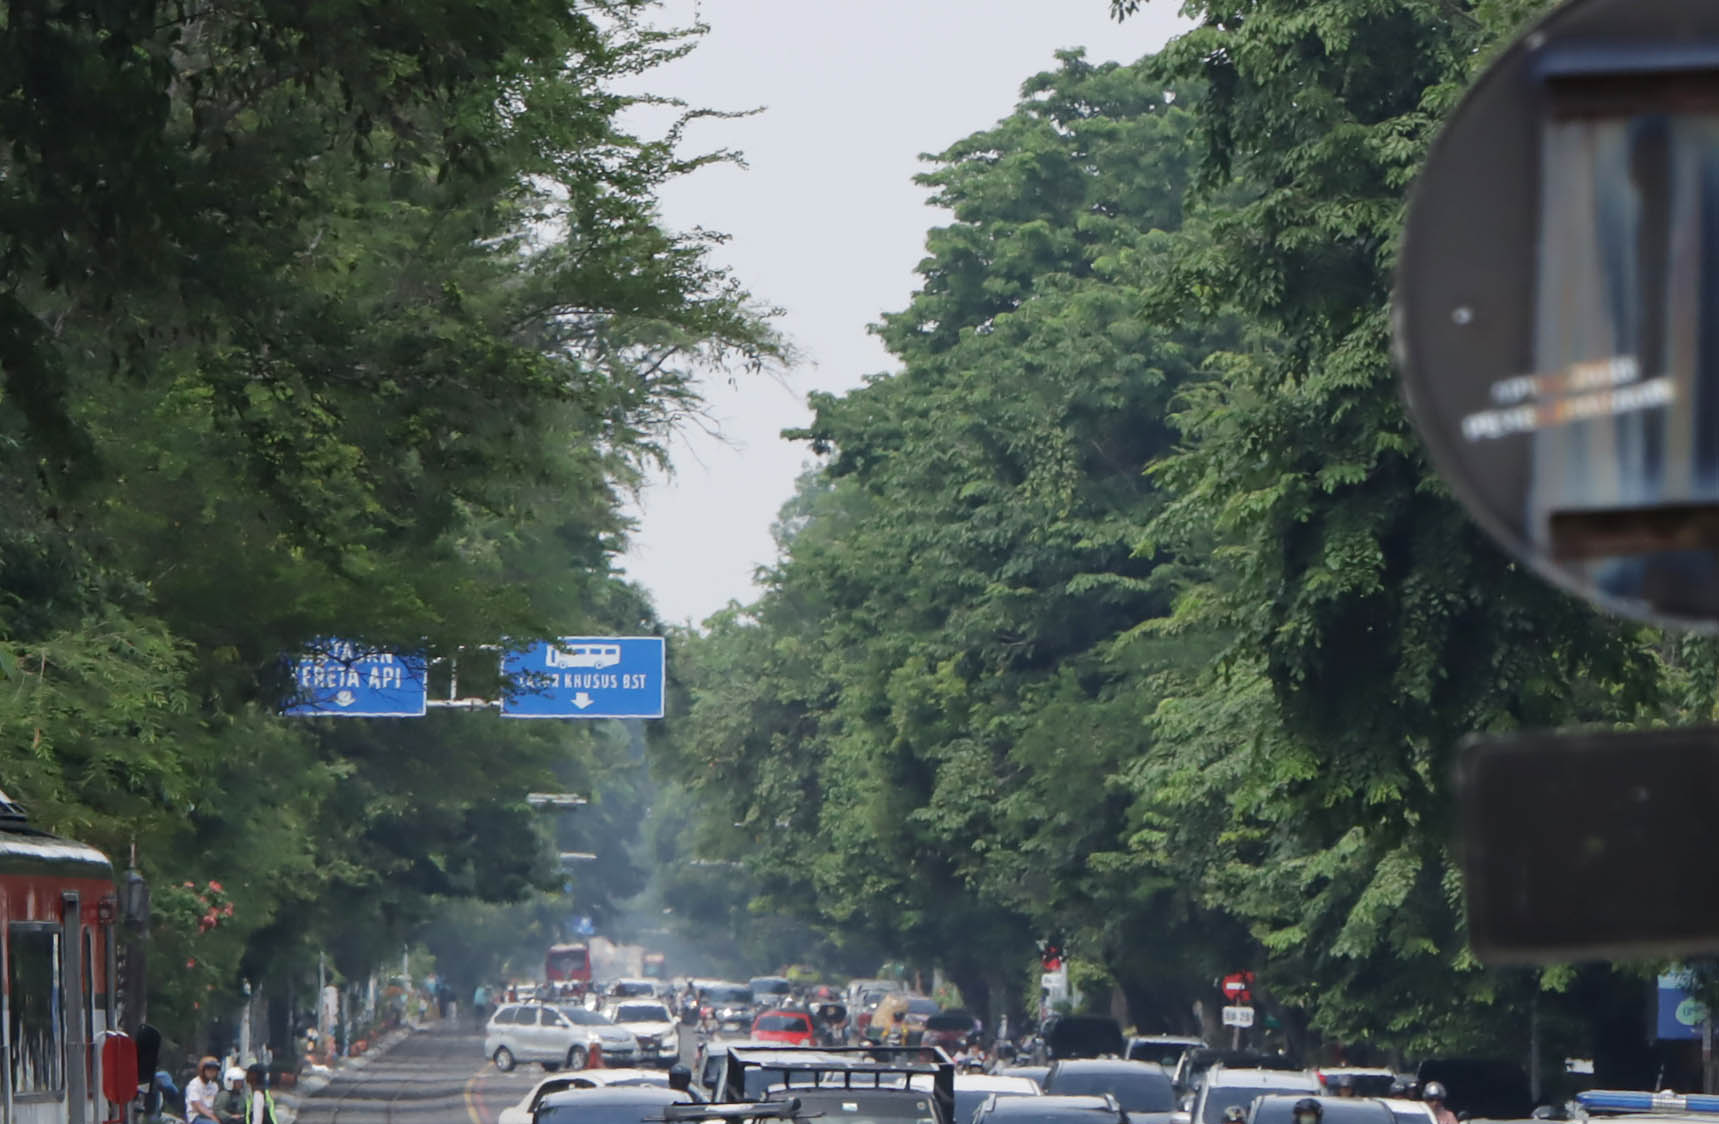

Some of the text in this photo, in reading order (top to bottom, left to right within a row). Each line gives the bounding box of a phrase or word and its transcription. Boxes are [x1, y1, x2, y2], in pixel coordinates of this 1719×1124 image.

[368, 667, 401, 689] API
[564, 673, 618, 689] KHUSUS
[623, 674, 647, 689] BST
